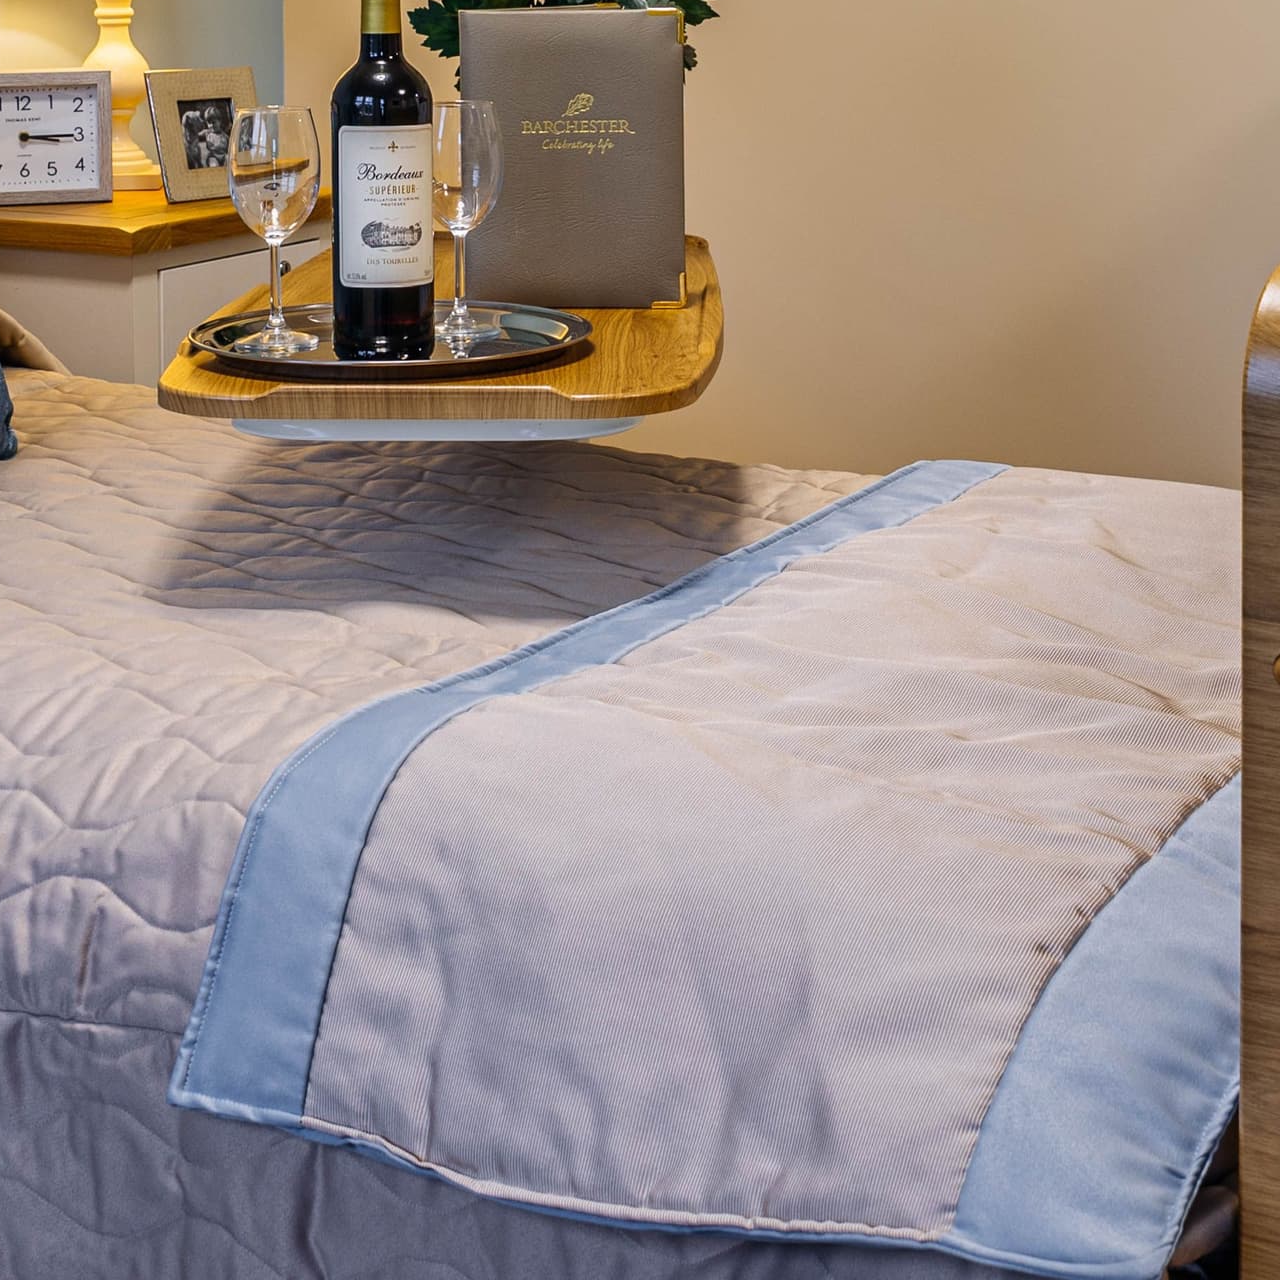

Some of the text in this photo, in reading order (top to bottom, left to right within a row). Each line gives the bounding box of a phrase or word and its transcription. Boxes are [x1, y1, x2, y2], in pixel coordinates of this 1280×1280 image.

[14, 95, 32, 111] 12
[47, 94, 54, 109] 1
[73, 97, 84, 112] 2
[73, 127, 85, 142] 3
[521, 120, 636, 135] BARCHESTER
[542, 138, 615, 155] Celebrating life
[20, 163, 30, 178] 6
[47, 161, 58, 176] 5
[75, 157, 85, 171] 4
[357, 162, 424, 181] Bordeaux
